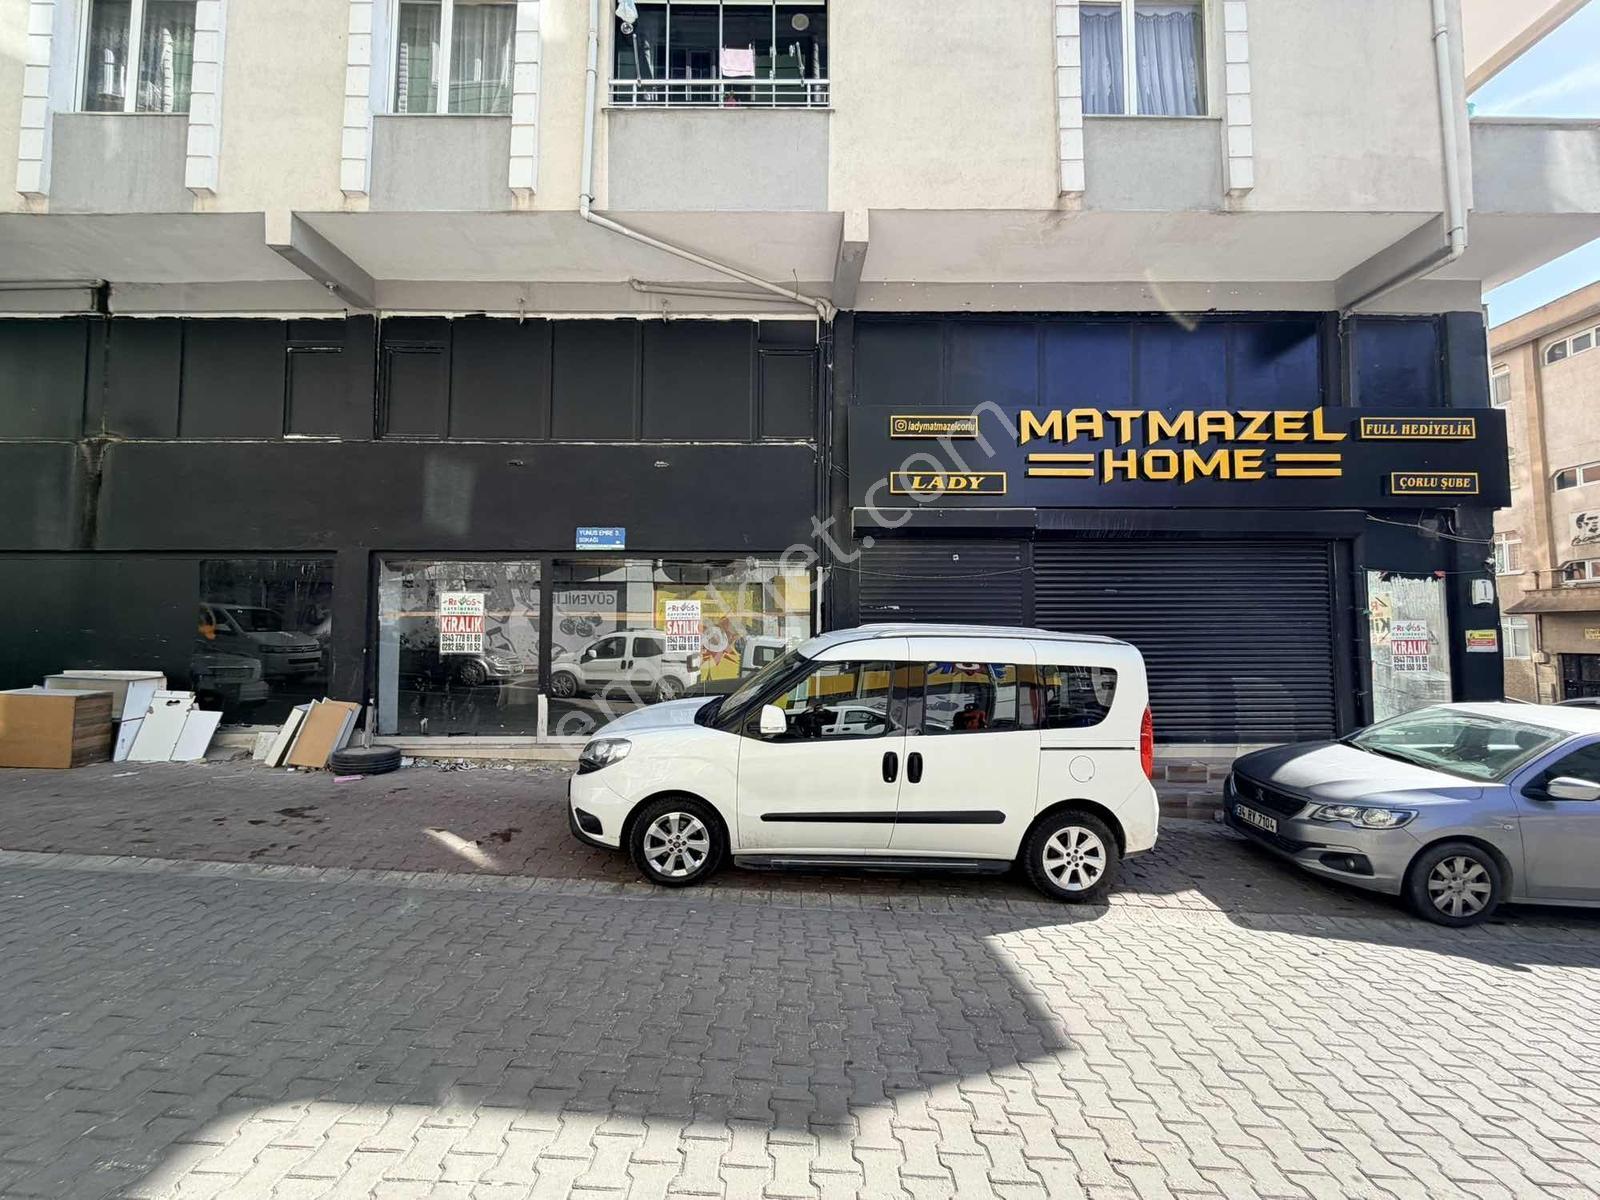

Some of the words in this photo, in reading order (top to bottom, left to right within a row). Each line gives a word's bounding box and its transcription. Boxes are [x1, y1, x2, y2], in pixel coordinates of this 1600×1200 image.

[1019, 406, 1347, 445] MATMAZEL
[1365, 423, 1398, 435] FULL
[1401, 421, 1472, 435] HEDİYELİK
[1103, 448, 1266, 484] HOME
[911, 476, 985, 489] LADY
[1399, 476, 1438, 490] ÇORLU
[1440, 476, 1472, 490] ŞUBE
[441, 616, 482, 633] KİRALIK
[666, 621, 700, 635] SATILIK
[1391, 640, 1427, 655] KİRALIK
[1237, 805, 1246, 818] 34
[1258, 814, 1275, 831] 7104
